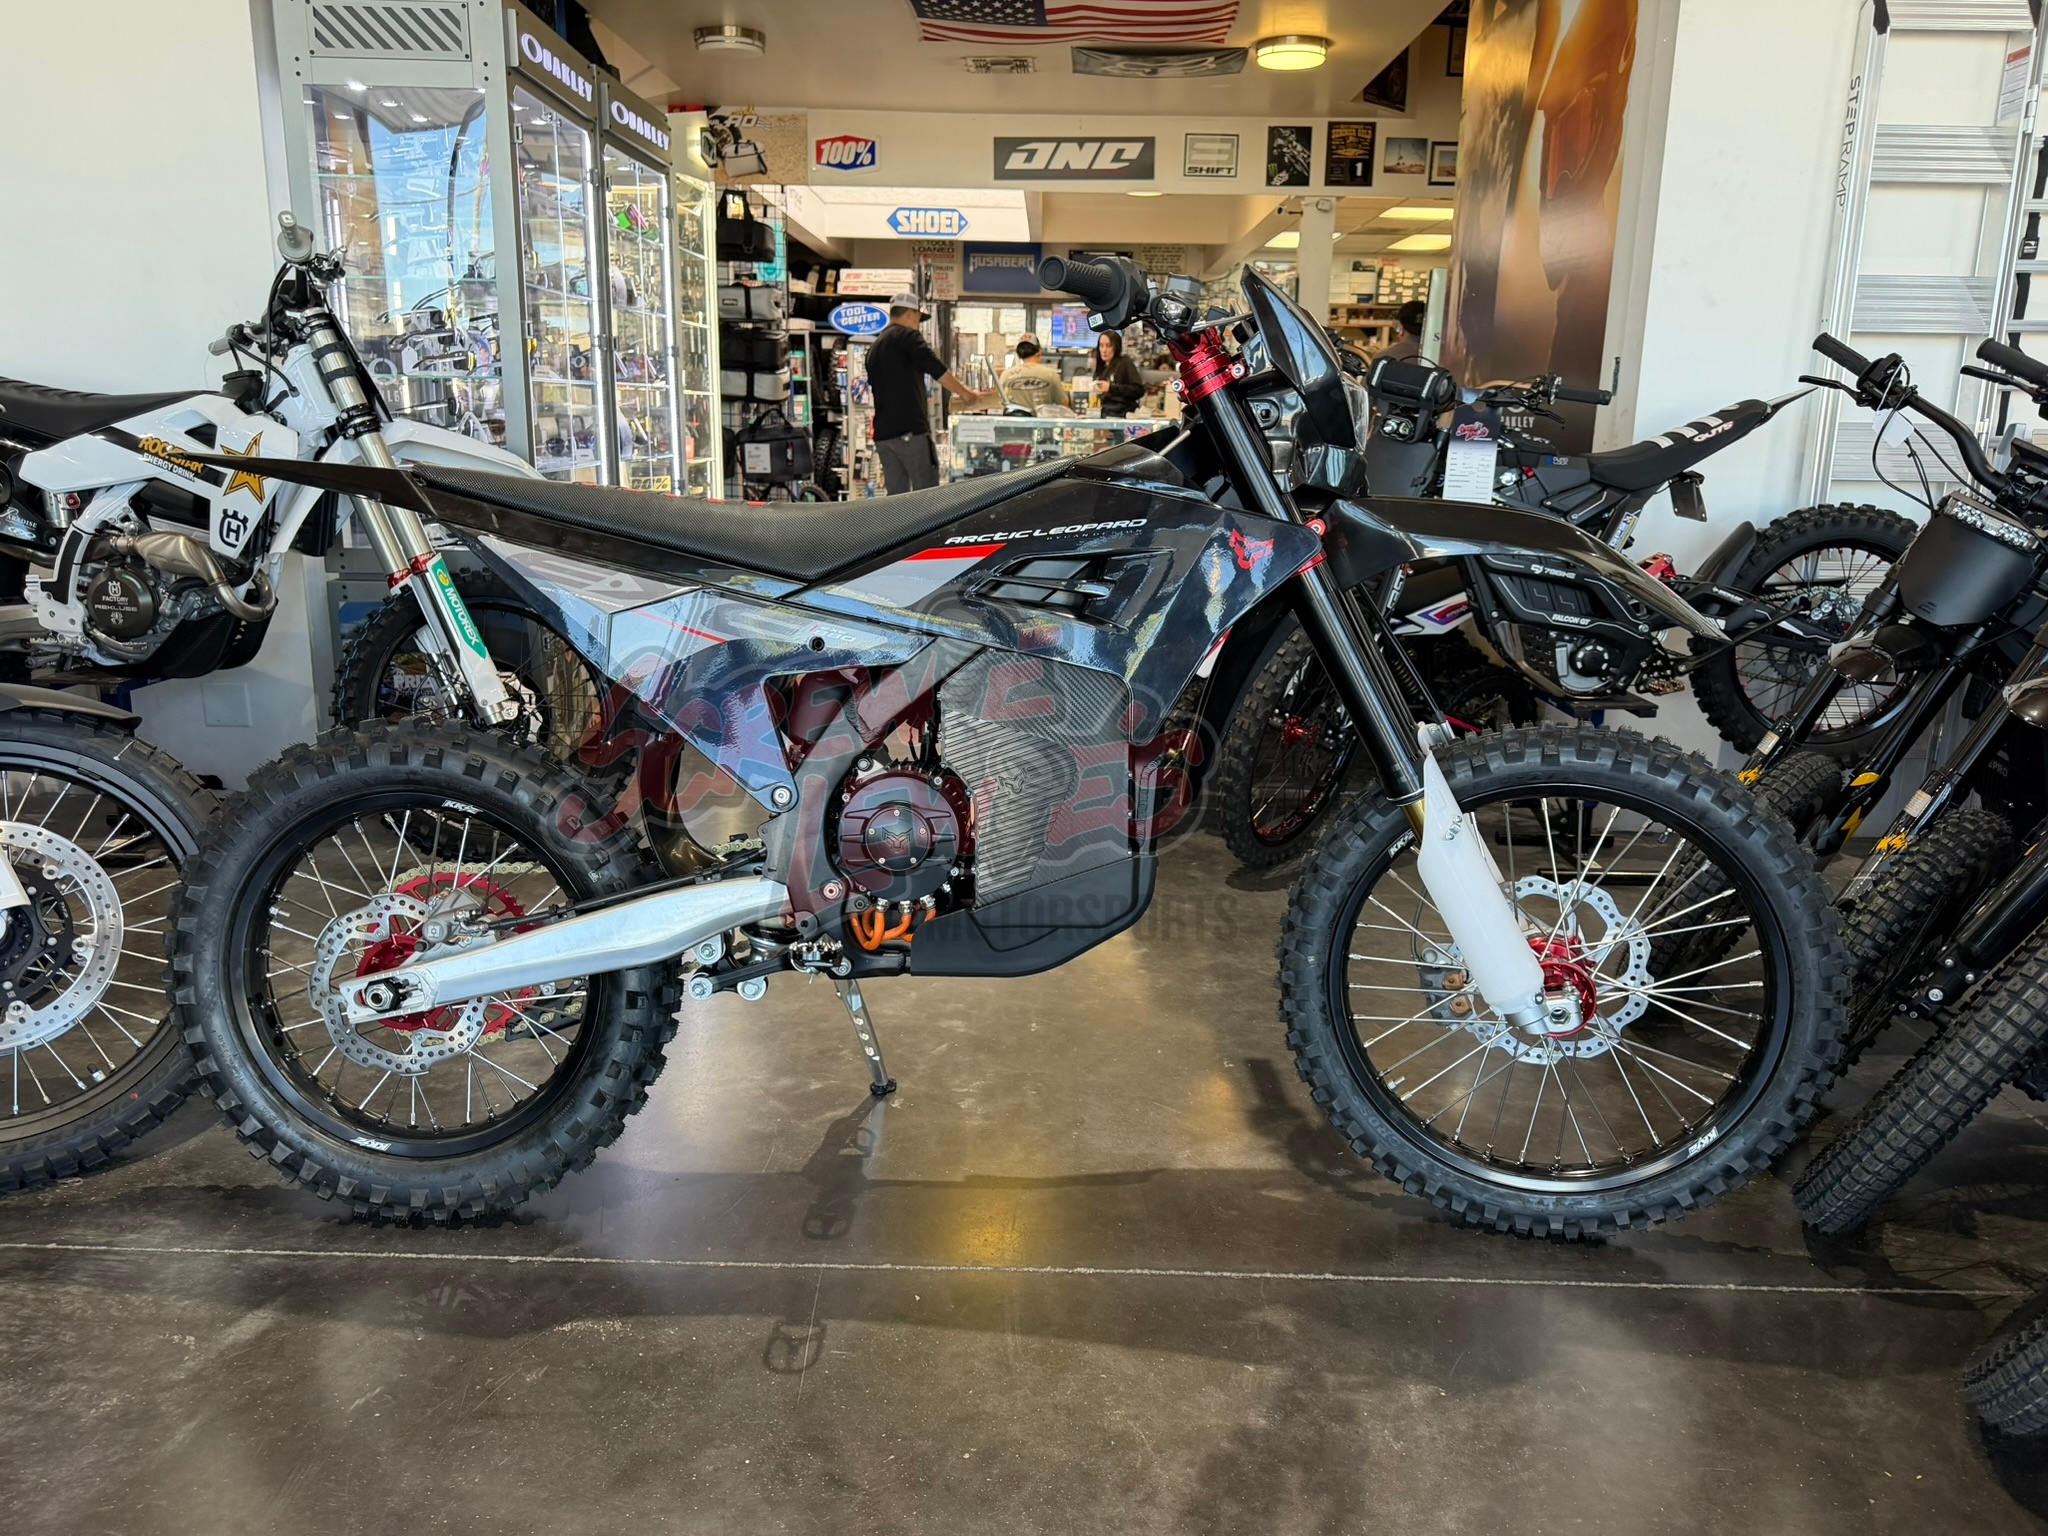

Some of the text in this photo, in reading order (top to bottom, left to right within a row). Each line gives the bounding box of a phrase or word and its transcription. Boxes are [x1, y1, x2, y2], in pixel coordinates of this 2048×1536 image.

[820, 141, 874, 165] 100%
[1187, 166, 1234, 175] SHIFT
[1355, 161, 1363, 176] 1
[895, 210, 960, 234] SHOEI
[970, 254, 1035, 273] HUSABERG
[840, 306, 867, 317] TOOL
[841, 312, 880, 326] CENTER
[142, 453, 195, 483] ENERGY DRINK
[1032, 518, 1147, 536] LEOPARD
[94, 604, 138, 612] REKLUSE
[445, 587, 479, 645] MOTOREX
[1552, 614, 1591, 626] FALCON GT
